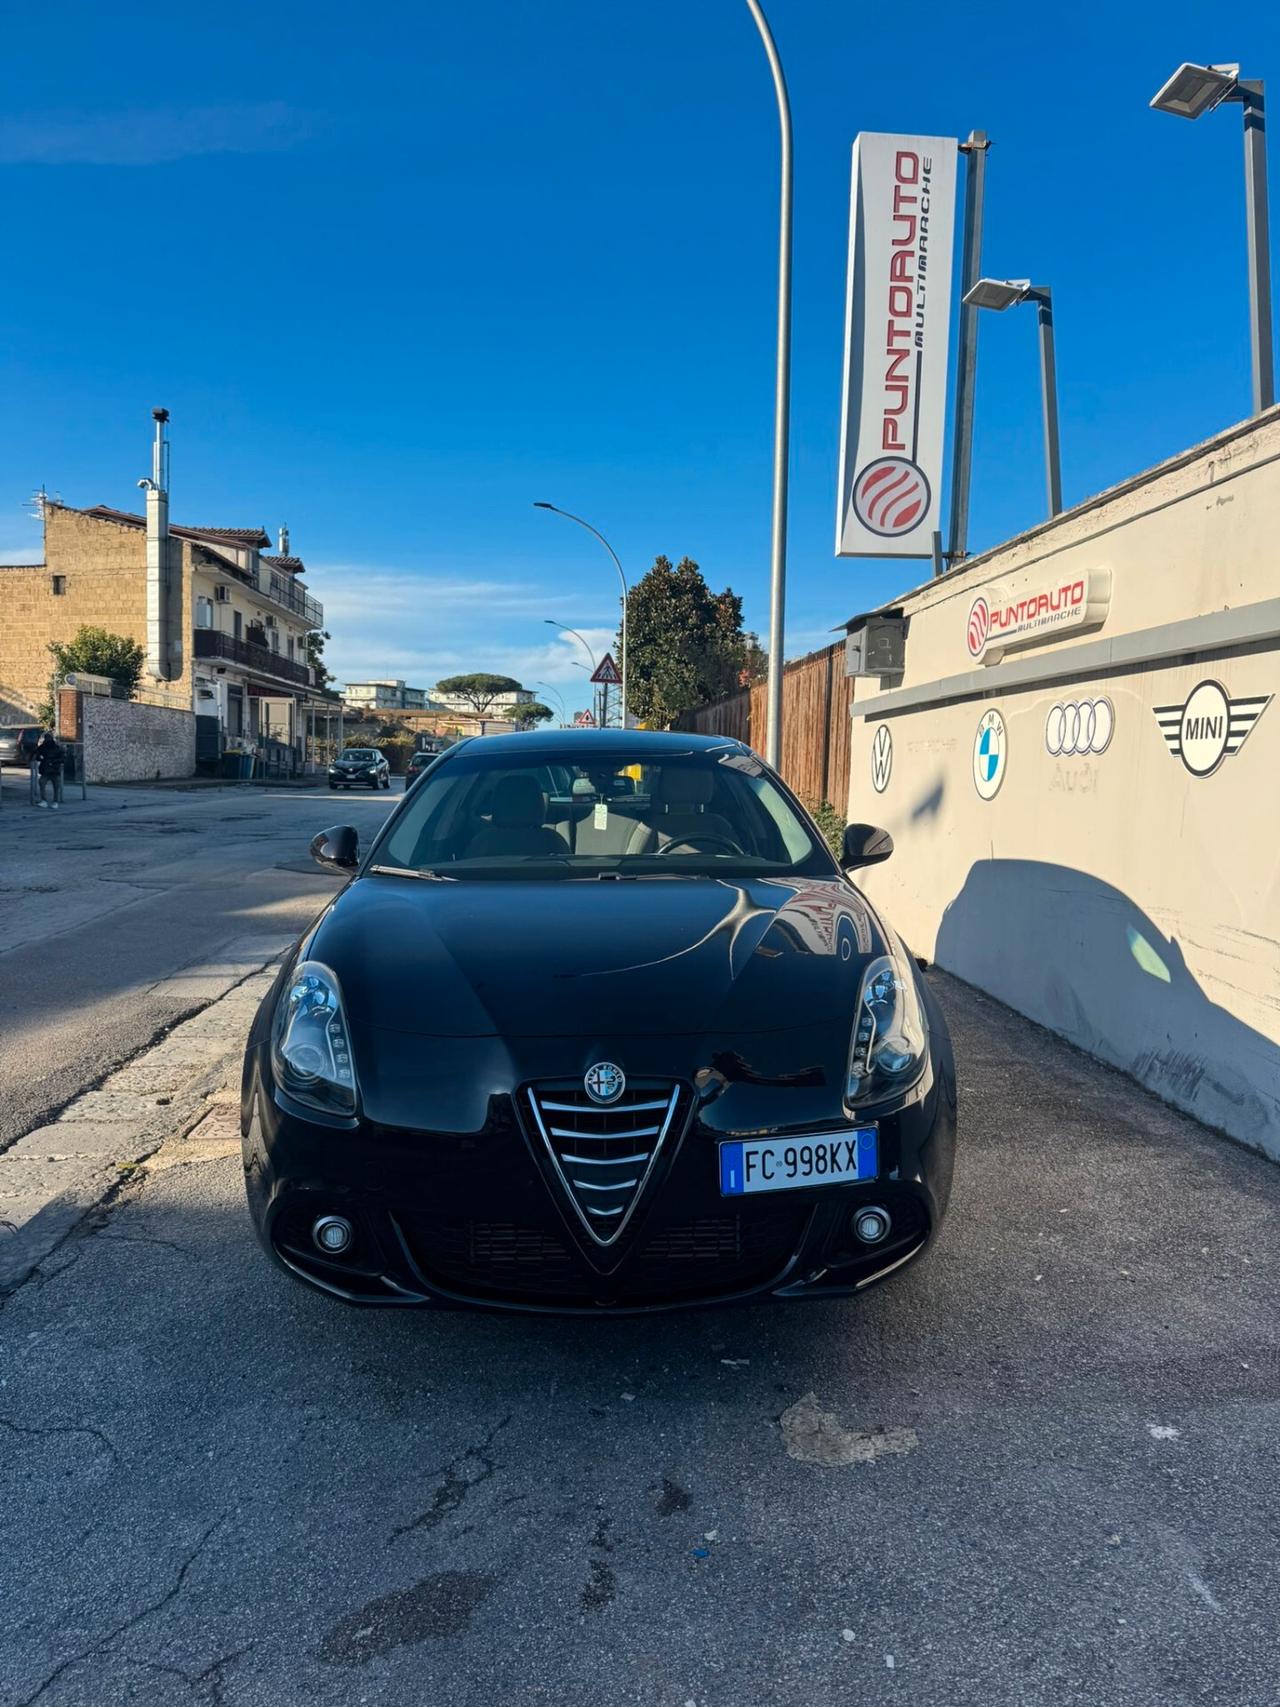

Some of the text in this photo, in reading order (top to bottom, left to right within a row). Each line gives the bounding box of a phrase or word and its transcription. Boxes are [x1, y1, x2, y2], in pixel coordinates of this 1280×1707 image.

[914, 156, 932, 349] MULTIMARCHE
[882, 150, 920, 451] PUNTOAUTO
[989, 580, 1084, 632] PUNTOAUTO
[1017, 606, 1082, 633] MULTIMARCHE
[1185, 715, 1223, 741] MINI
[745, 1149, 775, 1183] FC
[784, 1139, 857, 1179] 998KX
